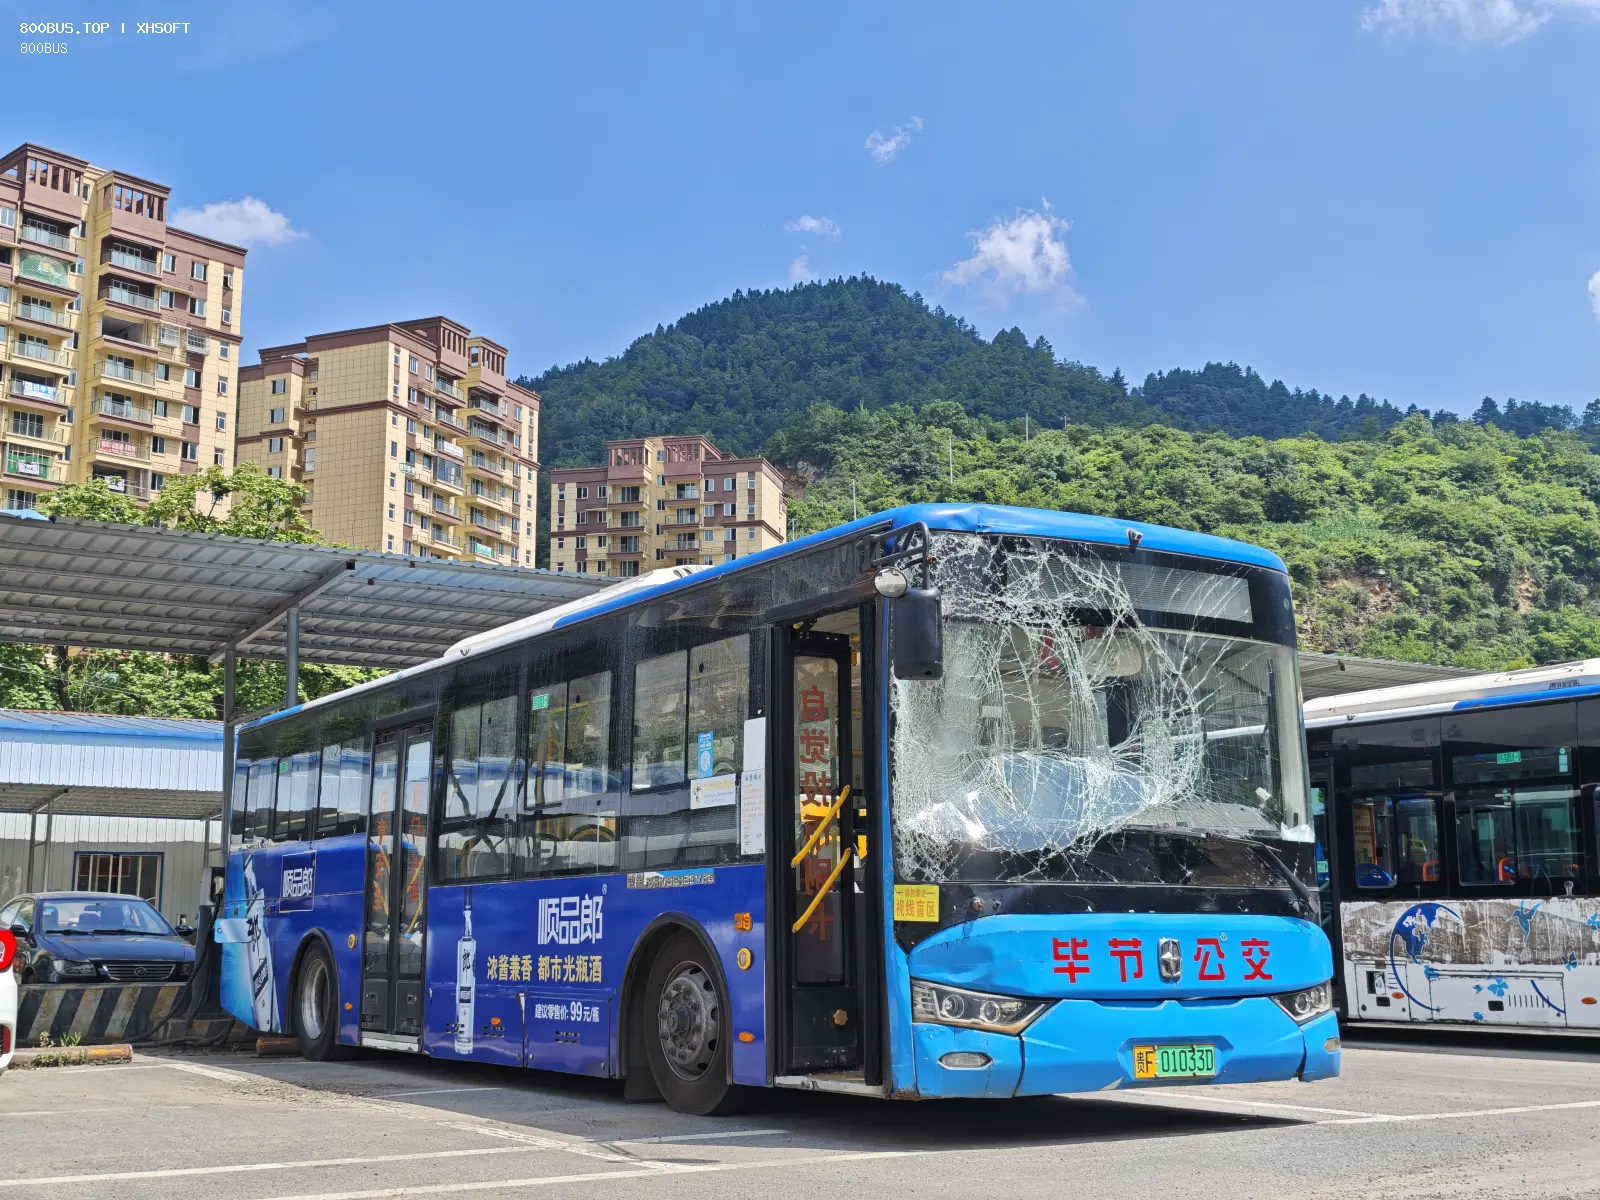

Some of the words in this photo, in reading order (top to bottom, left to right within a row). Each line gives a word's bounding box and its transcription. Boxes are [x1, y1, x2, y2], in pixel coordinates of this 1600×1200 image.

[282, 867, 313, 897] 顺品郎
[537, 893, 603, 945] 顺品郎
[896, 899, 936, 918] 视线盲区
[486, 955, 533, 981] 浓酱兼香
[537, 955, 603, 983] 都市光瓶酒
[1052, 937, 1143, 984] 毕节
[1193, 937, 1273, 981] 公交
